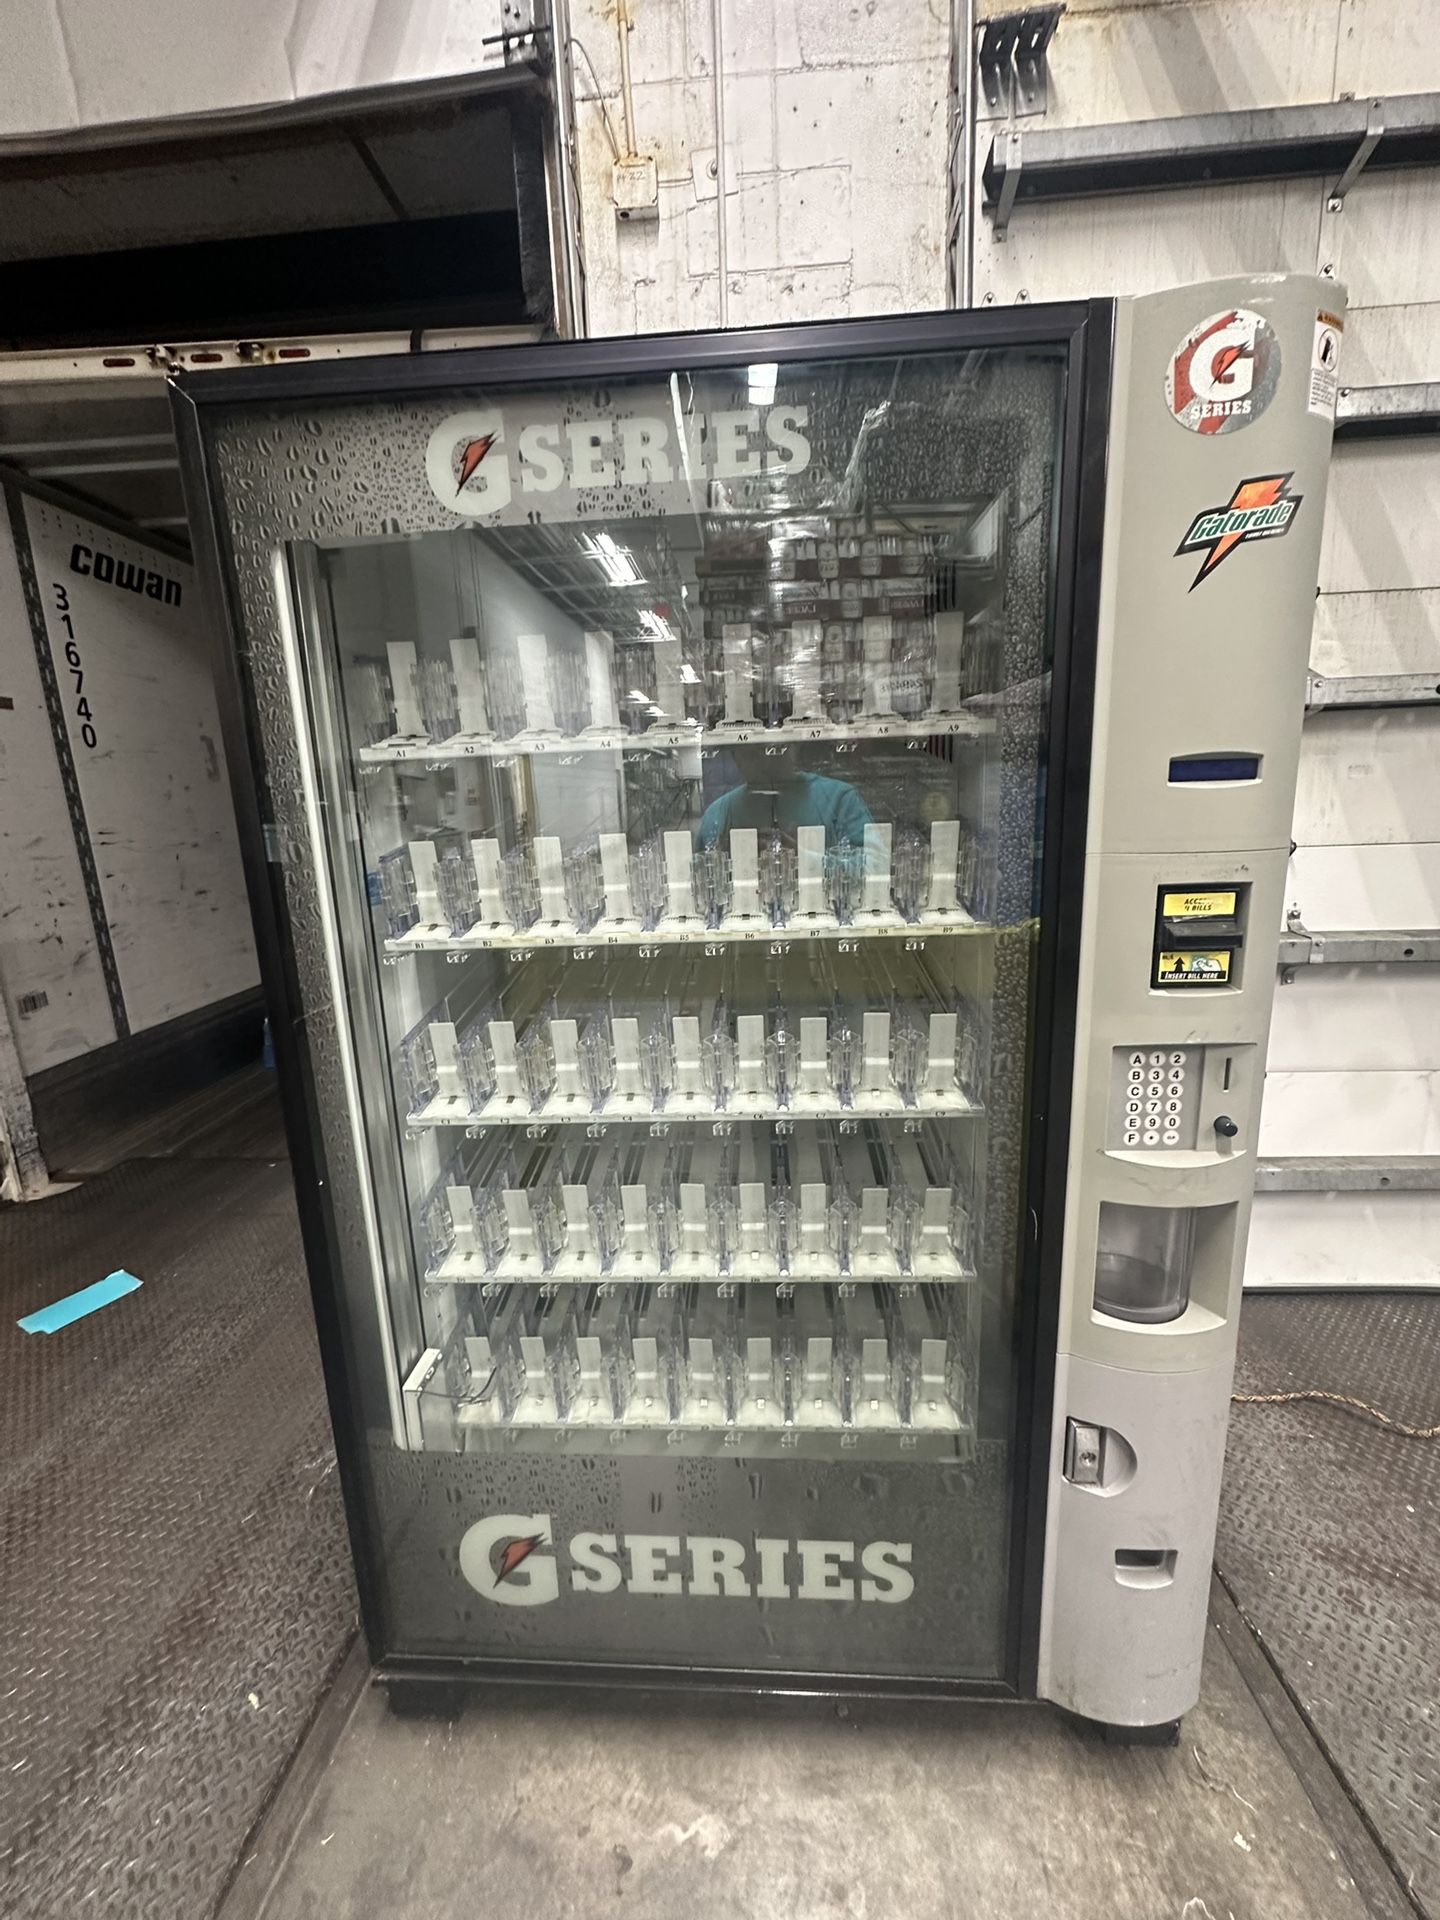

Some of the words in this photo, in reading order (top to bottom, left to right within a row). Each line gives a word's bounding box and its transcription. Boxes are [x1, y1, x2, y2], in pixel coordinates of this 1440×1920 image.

[1188, 320, 1256, 403] G
[1190, 399, 1252, 420] SERIES
[425, 408, 512, 516] G
[518, 404, 812, 492] SERIES
[1190, 501, 1293, 541] Gatorade
[464, 746, 475, 754] A2
[534, 743, 545, 751] A3
[600, 740, 611, 748] A4
[810, 730, 821, 738] A7
[948, 724, 959, 732] A9
[1164, 971, 1187, 979] INSERT
[1133, 1054, 1142, 1064] A
[1154, 1054, 1160, 1064] 1
[1174, 1054, 1181, 1064] 2
[1132, 1071, 1140, 1080] B
[1153, 1070, 1159, 1080] 3
[1172, 1070, 1179, 1079] 4
[1131, 1086, 1140, 1096] C
[1151, 1086, 1158, 1096] 5
[1171, 1086, 1178, 1095] 6
[1130, 1102, 1139, 1112] D
[1150, 1102, 1157, 1111] 7
[1170, 1102, 1177, 1111] 8
[1129, 1118, 1137, 1127] E
[1149, 1118, 1156, 1127] 9
[1169, 1117, 1176, 1127] 0
[1128, 1134, 1136, 1143] F
[458, 1513, 560, 1607] G
[568, 1531, 916, 1604] SERIES
